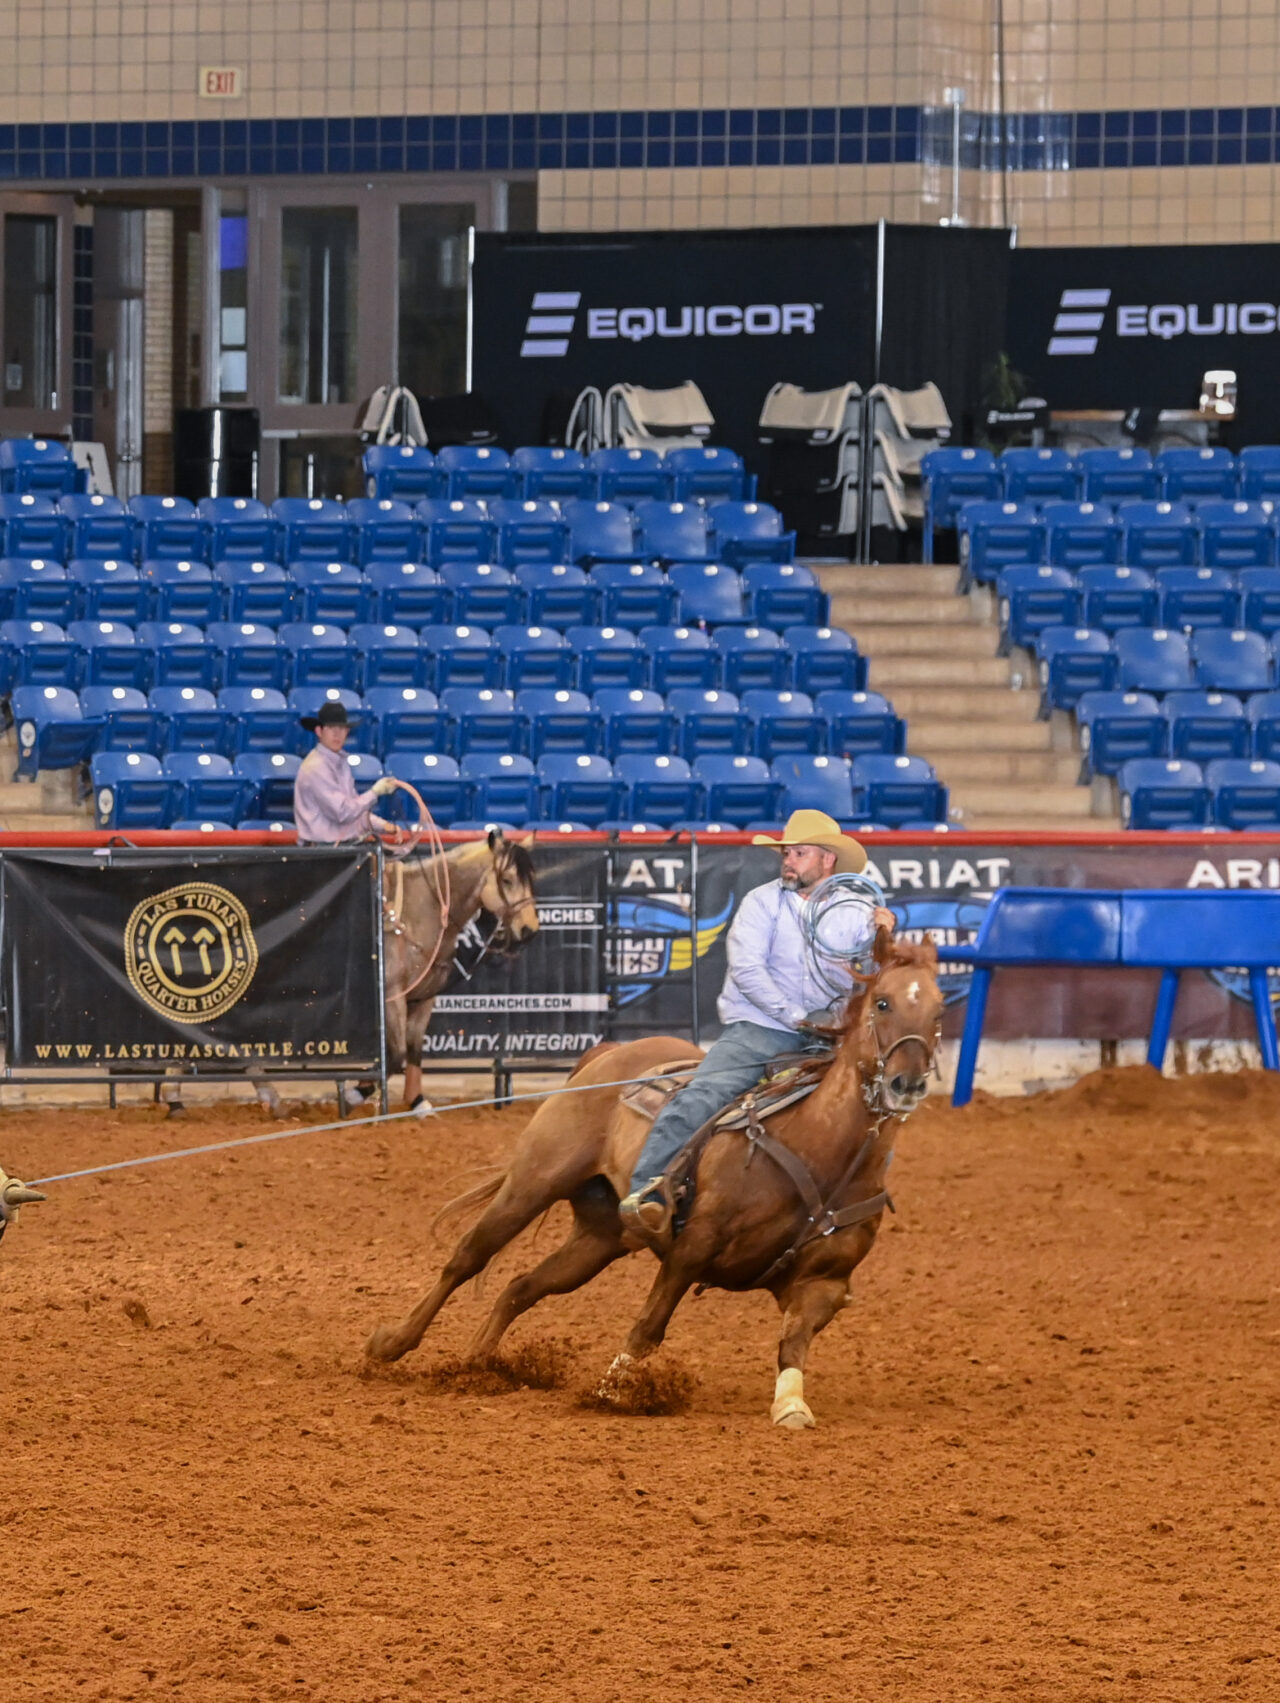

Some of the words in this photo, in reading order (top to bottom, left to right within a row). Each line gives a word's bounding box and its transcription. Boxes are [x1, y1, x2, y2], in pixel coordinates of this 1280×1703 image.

[207, 71, 235, 95] EXIT
[587, 303, 816, 341] EQUICOR
[1116, 303, 1280, 340] EQUIC
[863, 858, 1010, 889] ARIAT
[1186, 859, 1280, 889] ARI
[142, 899, 178, 926] LAS
[184, 894, 238, 928] TUNAS
[540, 909, 595, 923] NCHES
[139, 961, 197, 1011] QUARTER
[201, 960, 246, 1010] HORSES
[434, 998, 572, 1010] LIANCERANCHES.COM
[35, 1041, 349, 1059] WWW.LASTUNASCATTLE.COM
[505, 1033, 603, 1052] INTEGRITY
